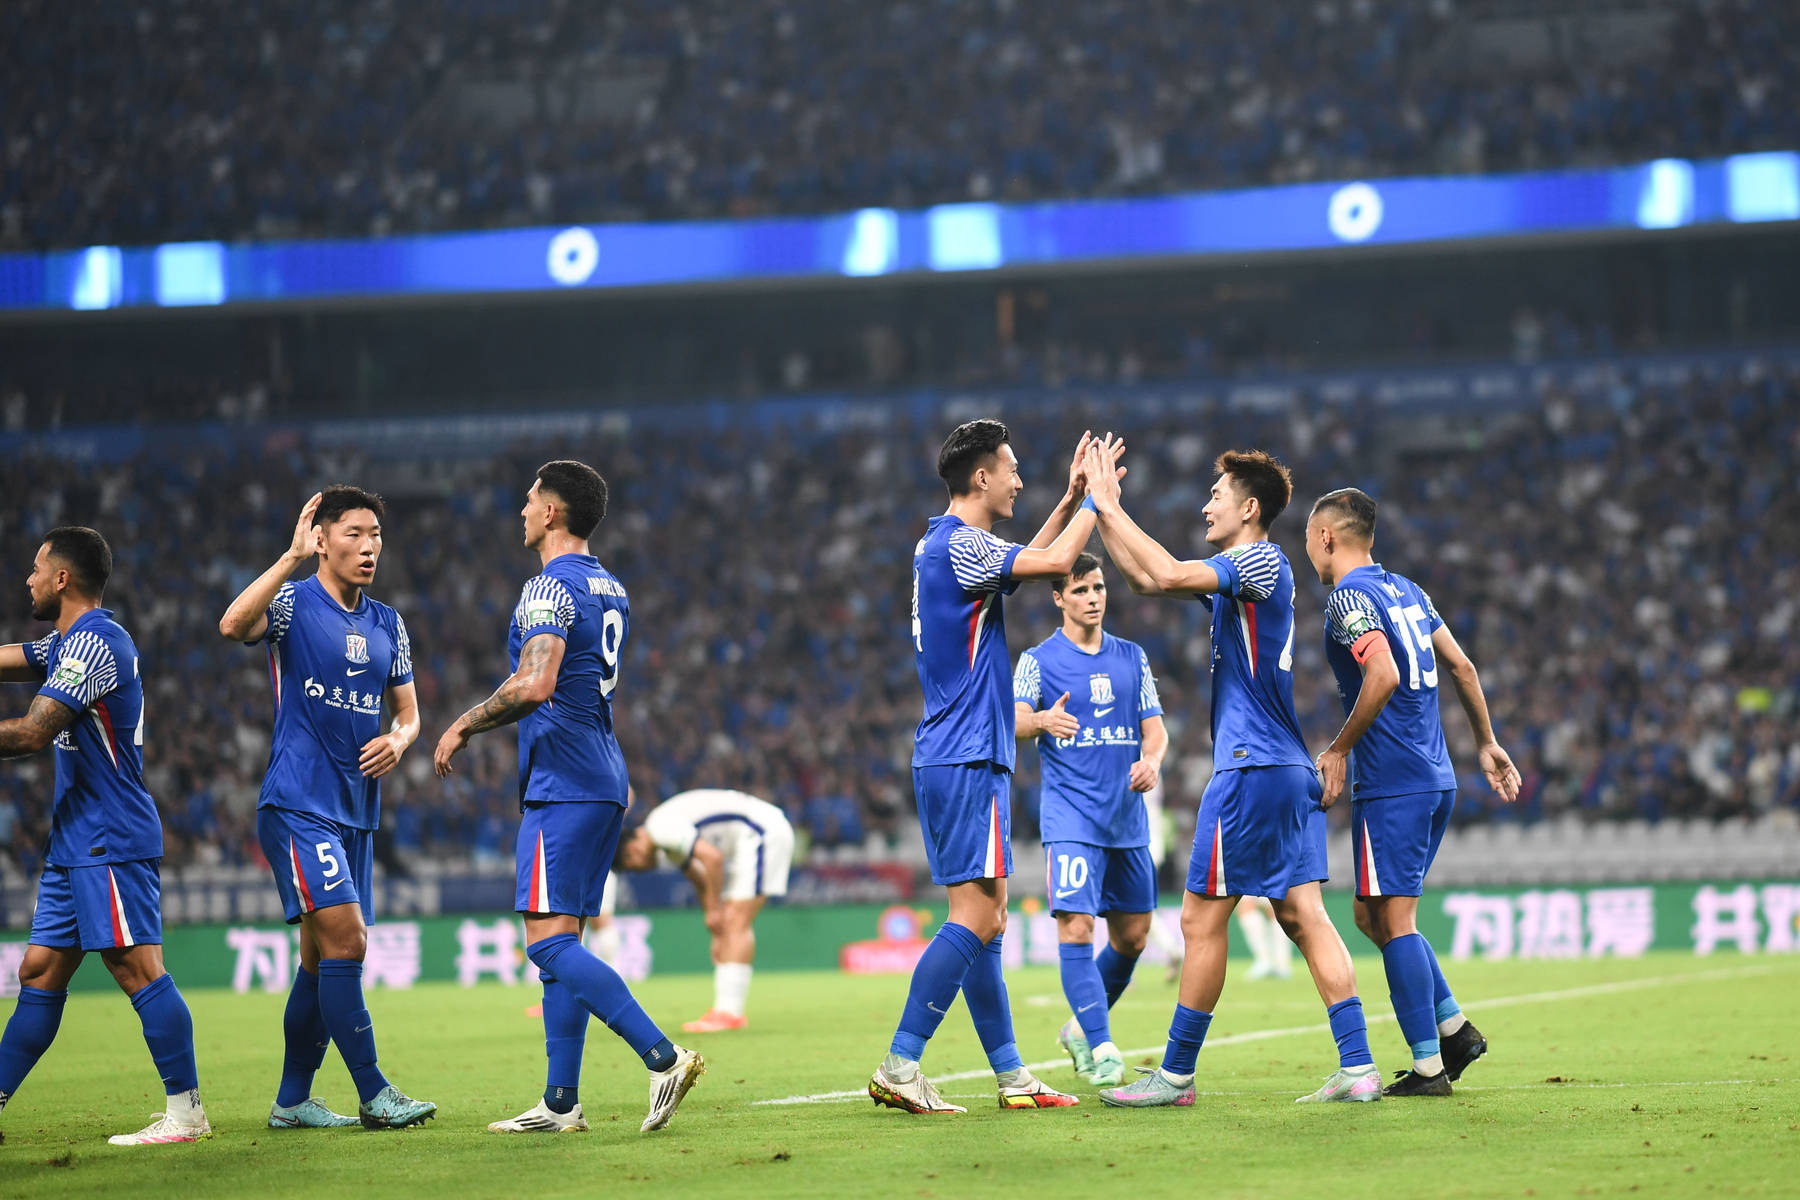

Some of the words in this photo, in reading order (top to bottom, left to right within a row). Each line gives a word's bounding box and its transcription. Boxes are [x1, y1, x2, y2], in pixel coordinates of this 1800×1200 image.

[599, 609, 624, 697] 9
[1387, 604, 1439, 690] 15
[315, 842, 339, 878] 5
[1057, 854, 1089, 888] 10
